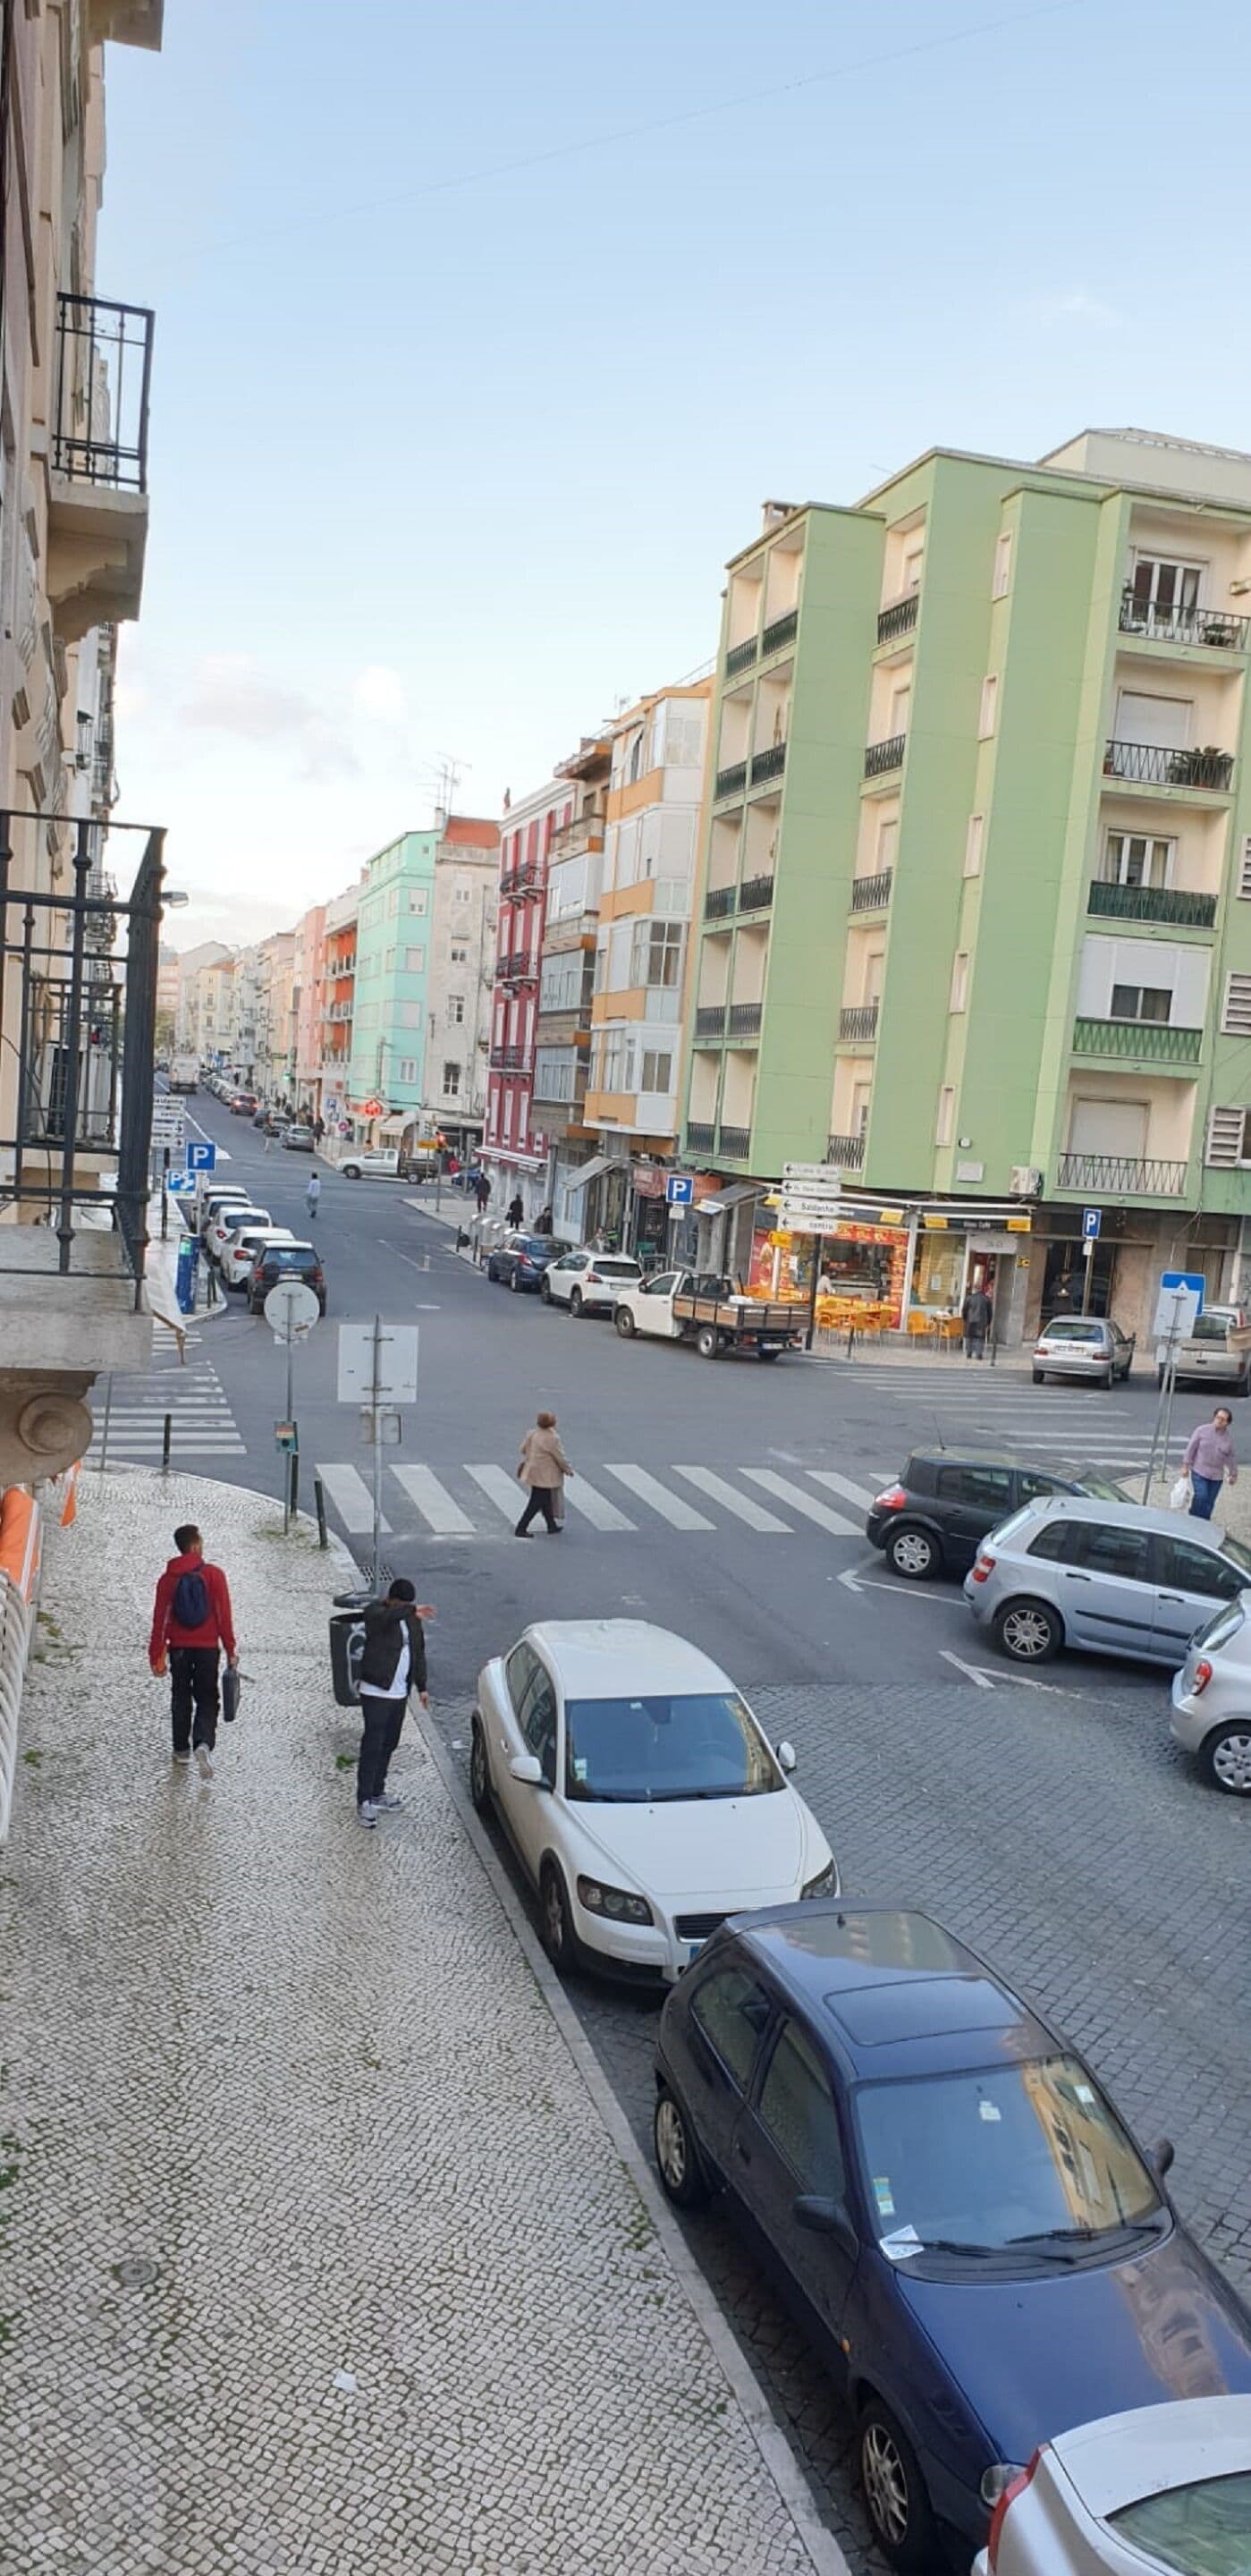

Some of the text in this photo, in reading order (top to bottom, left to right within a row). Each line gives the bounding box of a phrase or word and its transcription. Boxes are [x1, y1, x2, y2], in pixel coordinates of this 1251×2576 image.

[193, 1146, 208, 1166] P
[672, 1180, 687, 1199] P
[1086, 1213, 1096, 1233] P
